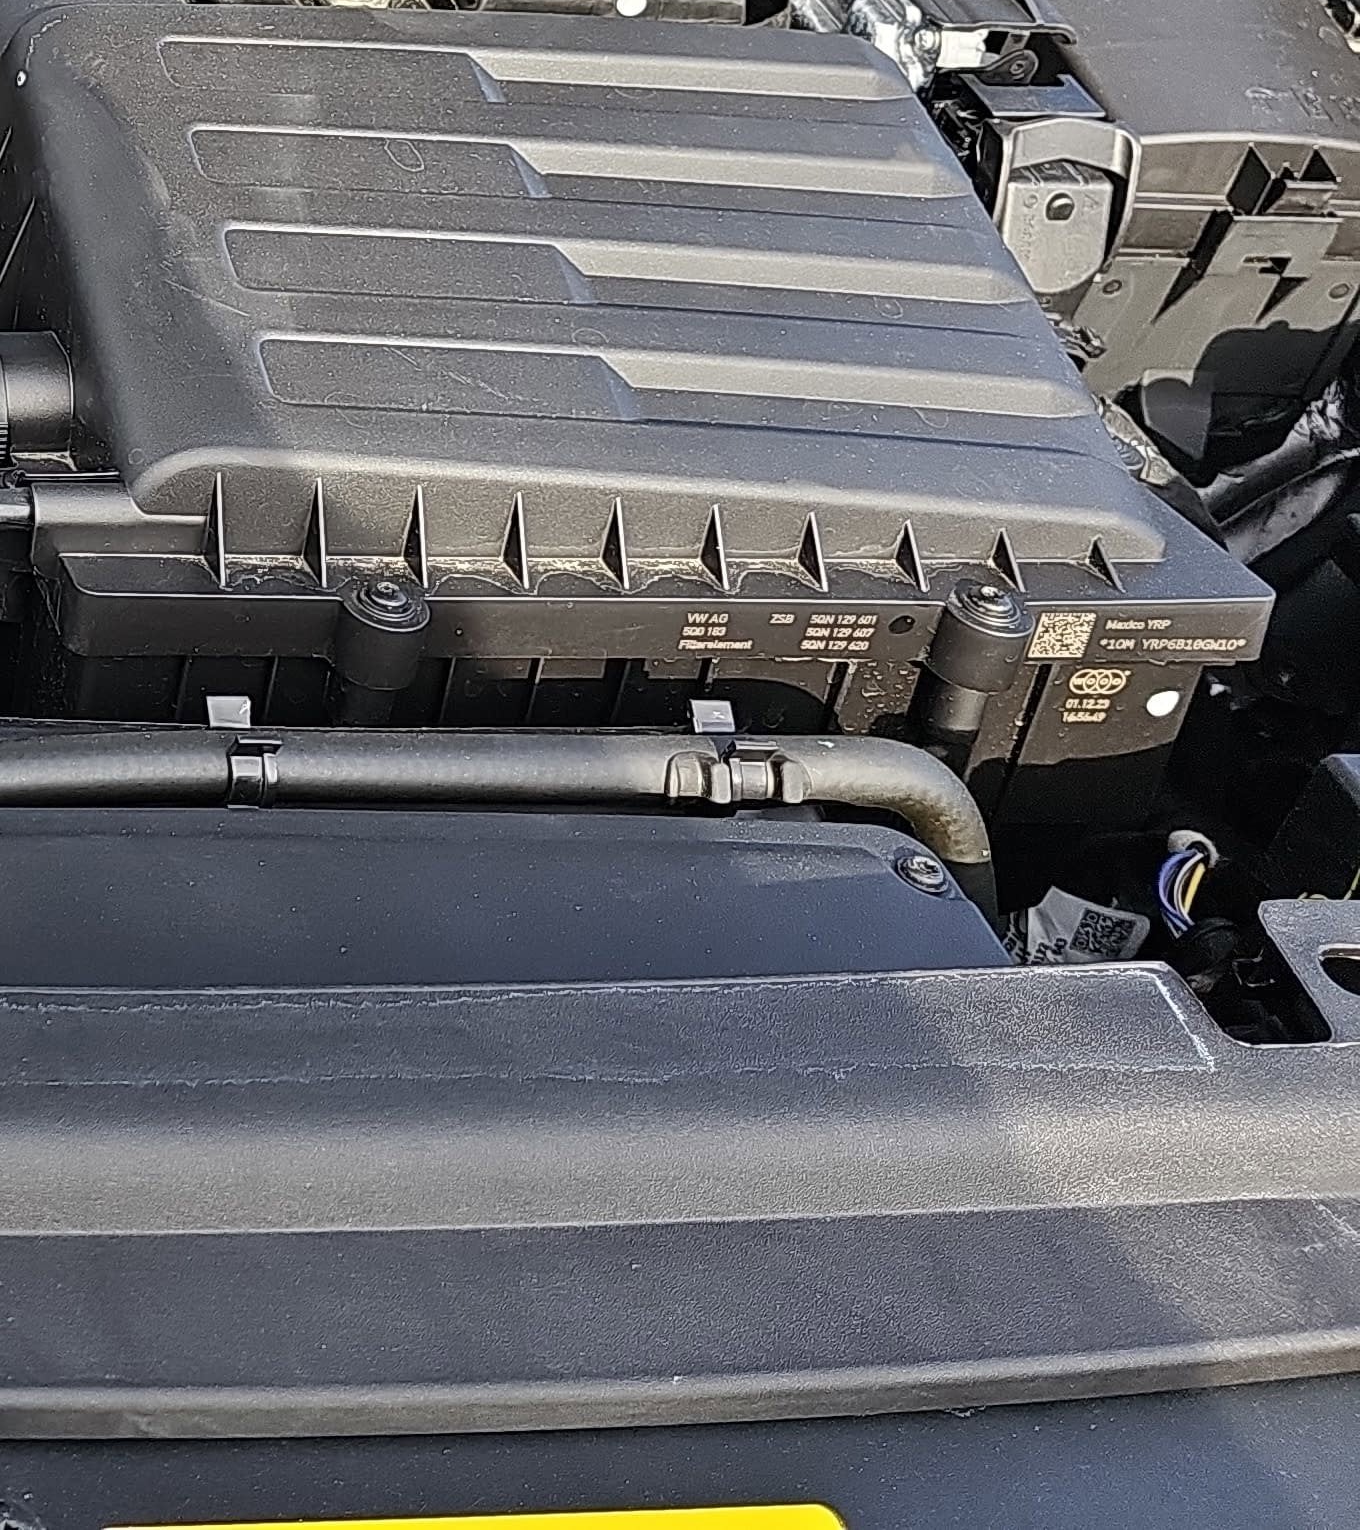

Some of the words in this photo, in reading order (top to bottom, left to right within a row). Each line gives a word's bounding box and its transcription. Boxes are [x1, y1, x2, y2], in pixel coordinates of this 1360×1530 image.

[687, 613, 708, 624] VW
[709, 613, 729, 624] AG
[769, 613, 795, 624] ZSB
[836, 614, 856, 624] 129
[1104, 619, 1146, 630] Mexico
[1147, 619, 1172, 630] YRP
[831, 627, 851, 637] 129
[678, 640, 753, 650] Filterelement
[827, 639, 847, 650] 129
